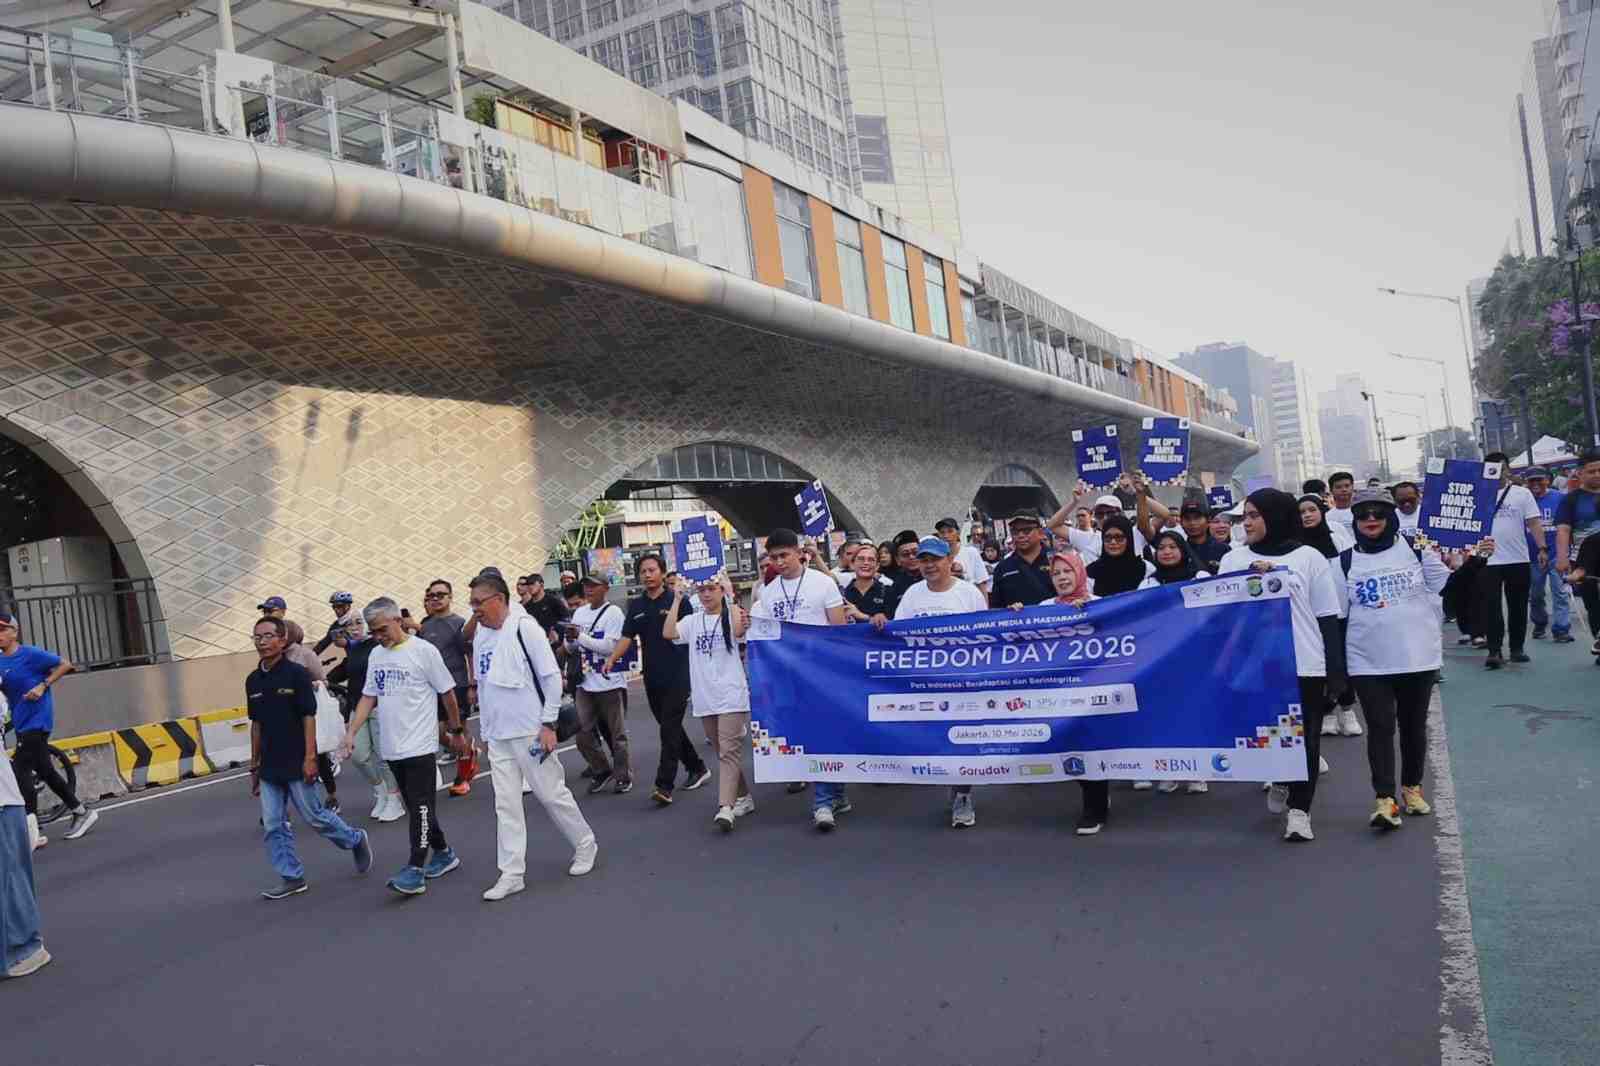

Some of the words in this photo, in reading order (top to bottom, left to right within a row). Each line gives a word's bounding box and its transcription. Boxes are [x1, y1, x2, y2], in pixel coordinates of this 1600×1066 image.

[1448, 482, 1474, 494] STOP
[1440, 493, 1476, 509] HOAKS,
[1440, 506, 1474, 519] MULAI
[1428, 515, 1482, 532] VERIFIKASI
[934, 623, 972, 635] BERSAMA
[973, 620, 997, 631] AWAK
[865, 646, 992, 670] FREEDOM
[1001, 640, 1060, 665] DAY
[1068, 634, 1137, 661] 2026
[1021, 727, 1044, 737] 2026
[1169, 758, 1198, 772] BNI
